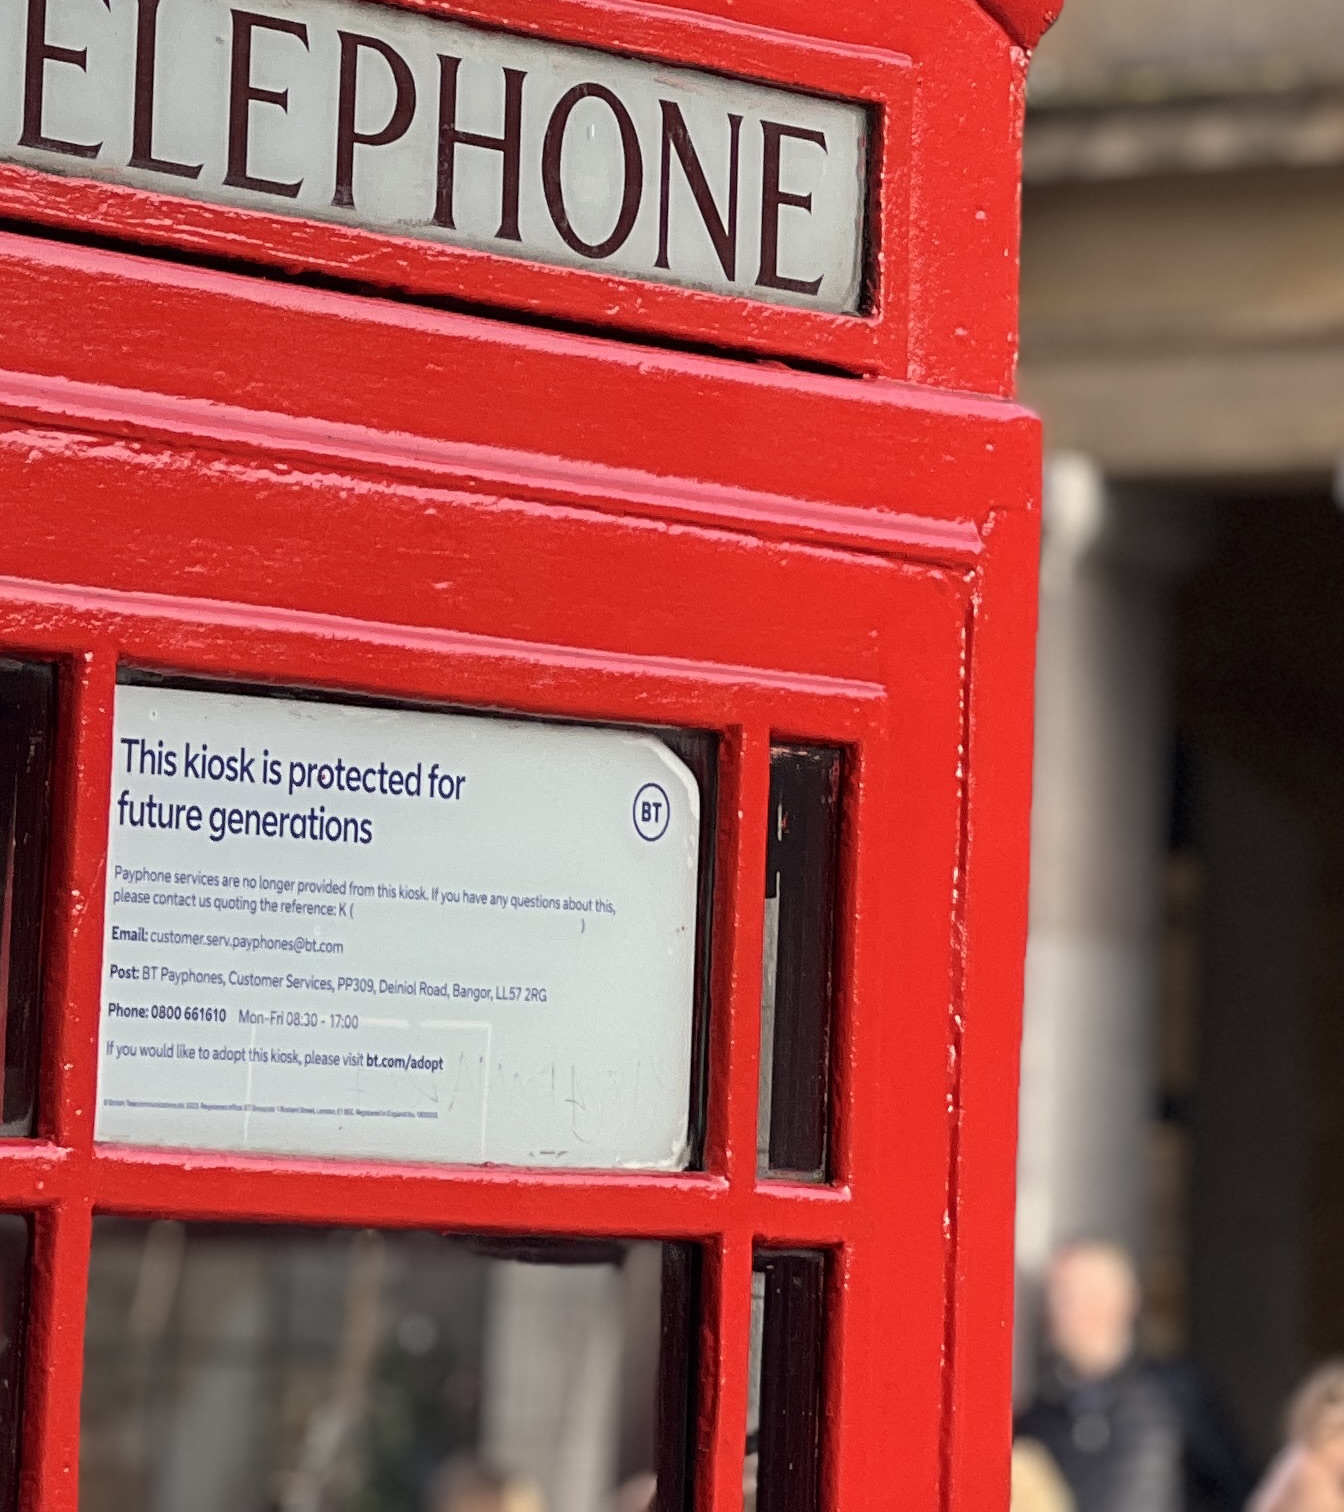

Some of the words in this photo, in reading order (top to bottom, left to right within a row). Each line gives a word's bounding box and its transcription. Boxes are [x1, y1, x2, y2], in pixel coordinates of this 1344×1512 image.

[121, 737, 177, 777] This
[184, 742, 255, 783] kiosk
[263, 749, 282, 785] is
[289, 758, 421, 797] protected
[428, 764, 465, 800] for
[118, 790, 202, 831] future
[209, 805, 372, 844] generations
[641, 801, 662, 823] BT
[113, 888, 150, 905] please
[153, 892, 196, 907] contact
[199, 897, 211, 908] us
[214, 896, 257, 914] quoting
[260, 897, 278, 912] the
[280, 898, 336, 916] reference:
[115, 865, 171, 884] Payphone
[174, 871, 219, 886] services
[222, 876, 240, 888] are
[243, 878, 257, 889] no
[259, 875, 295, 894] longer
[297, 879, 346, 895] provided
[349, 881, 375, 896] from
[377, 884, 396, 898] this
[399, 885, 429, 900] kiosk.
[432, 887, 439, 901] If
[441, 892, 460, 905] you
[463, 890, 487, 905] have
[490, 895, 508, 909] any
[511, 895, 560, 909] questions
[563, 896, 593, 911] about
[595, 899, 615, 916] this,
[112, 926, 148, 942] Email:
[150, 930, 343, 954] customer.serv.payphones@bt.com
[110, 964, 140, 980] Post:
[142, 966, 158, 980] BT
[161, 967, 226, 987] Payphones,
[229, 970, 284, 988] Customer
[286, 974, 335, 993] Services,
[338, 977, 376, 995] PP309,
[419, 981, 450, 999] Road,
[453, 983, 493, 1002] Bangor,
[496, 986, 521, 1000] LL57
[525, 988, 547, 1002] 2RG
[108, 1002, 149, 1019] Phone:
[151, 1004, 182, 1022] 0800
[184, 1006, 227, 1024] 661610
[238, 1009, 284, 1025] Mon-Fri
[286, 1012, 318, 1027] 08:30
[330, 1014, 358, 1029] 17:00
[107, 1040, 114, 1055] If
[116, 1045, 137, 1059] you
[139, 1043, 174, 1058] would
[176, 1044, 196, 1059] like
[198, 1046, 210, 1060] to
[212, 1045, 246, 1064] adopt
[248, 1047, 268, 1063] this
[271, 1048, 302, 1066] kiosk,
[304, 1050, 340, 1067] please
[342, 1052, 364, 1067] visit
[366, 1052, 444, 1073] bt.com/adopt
